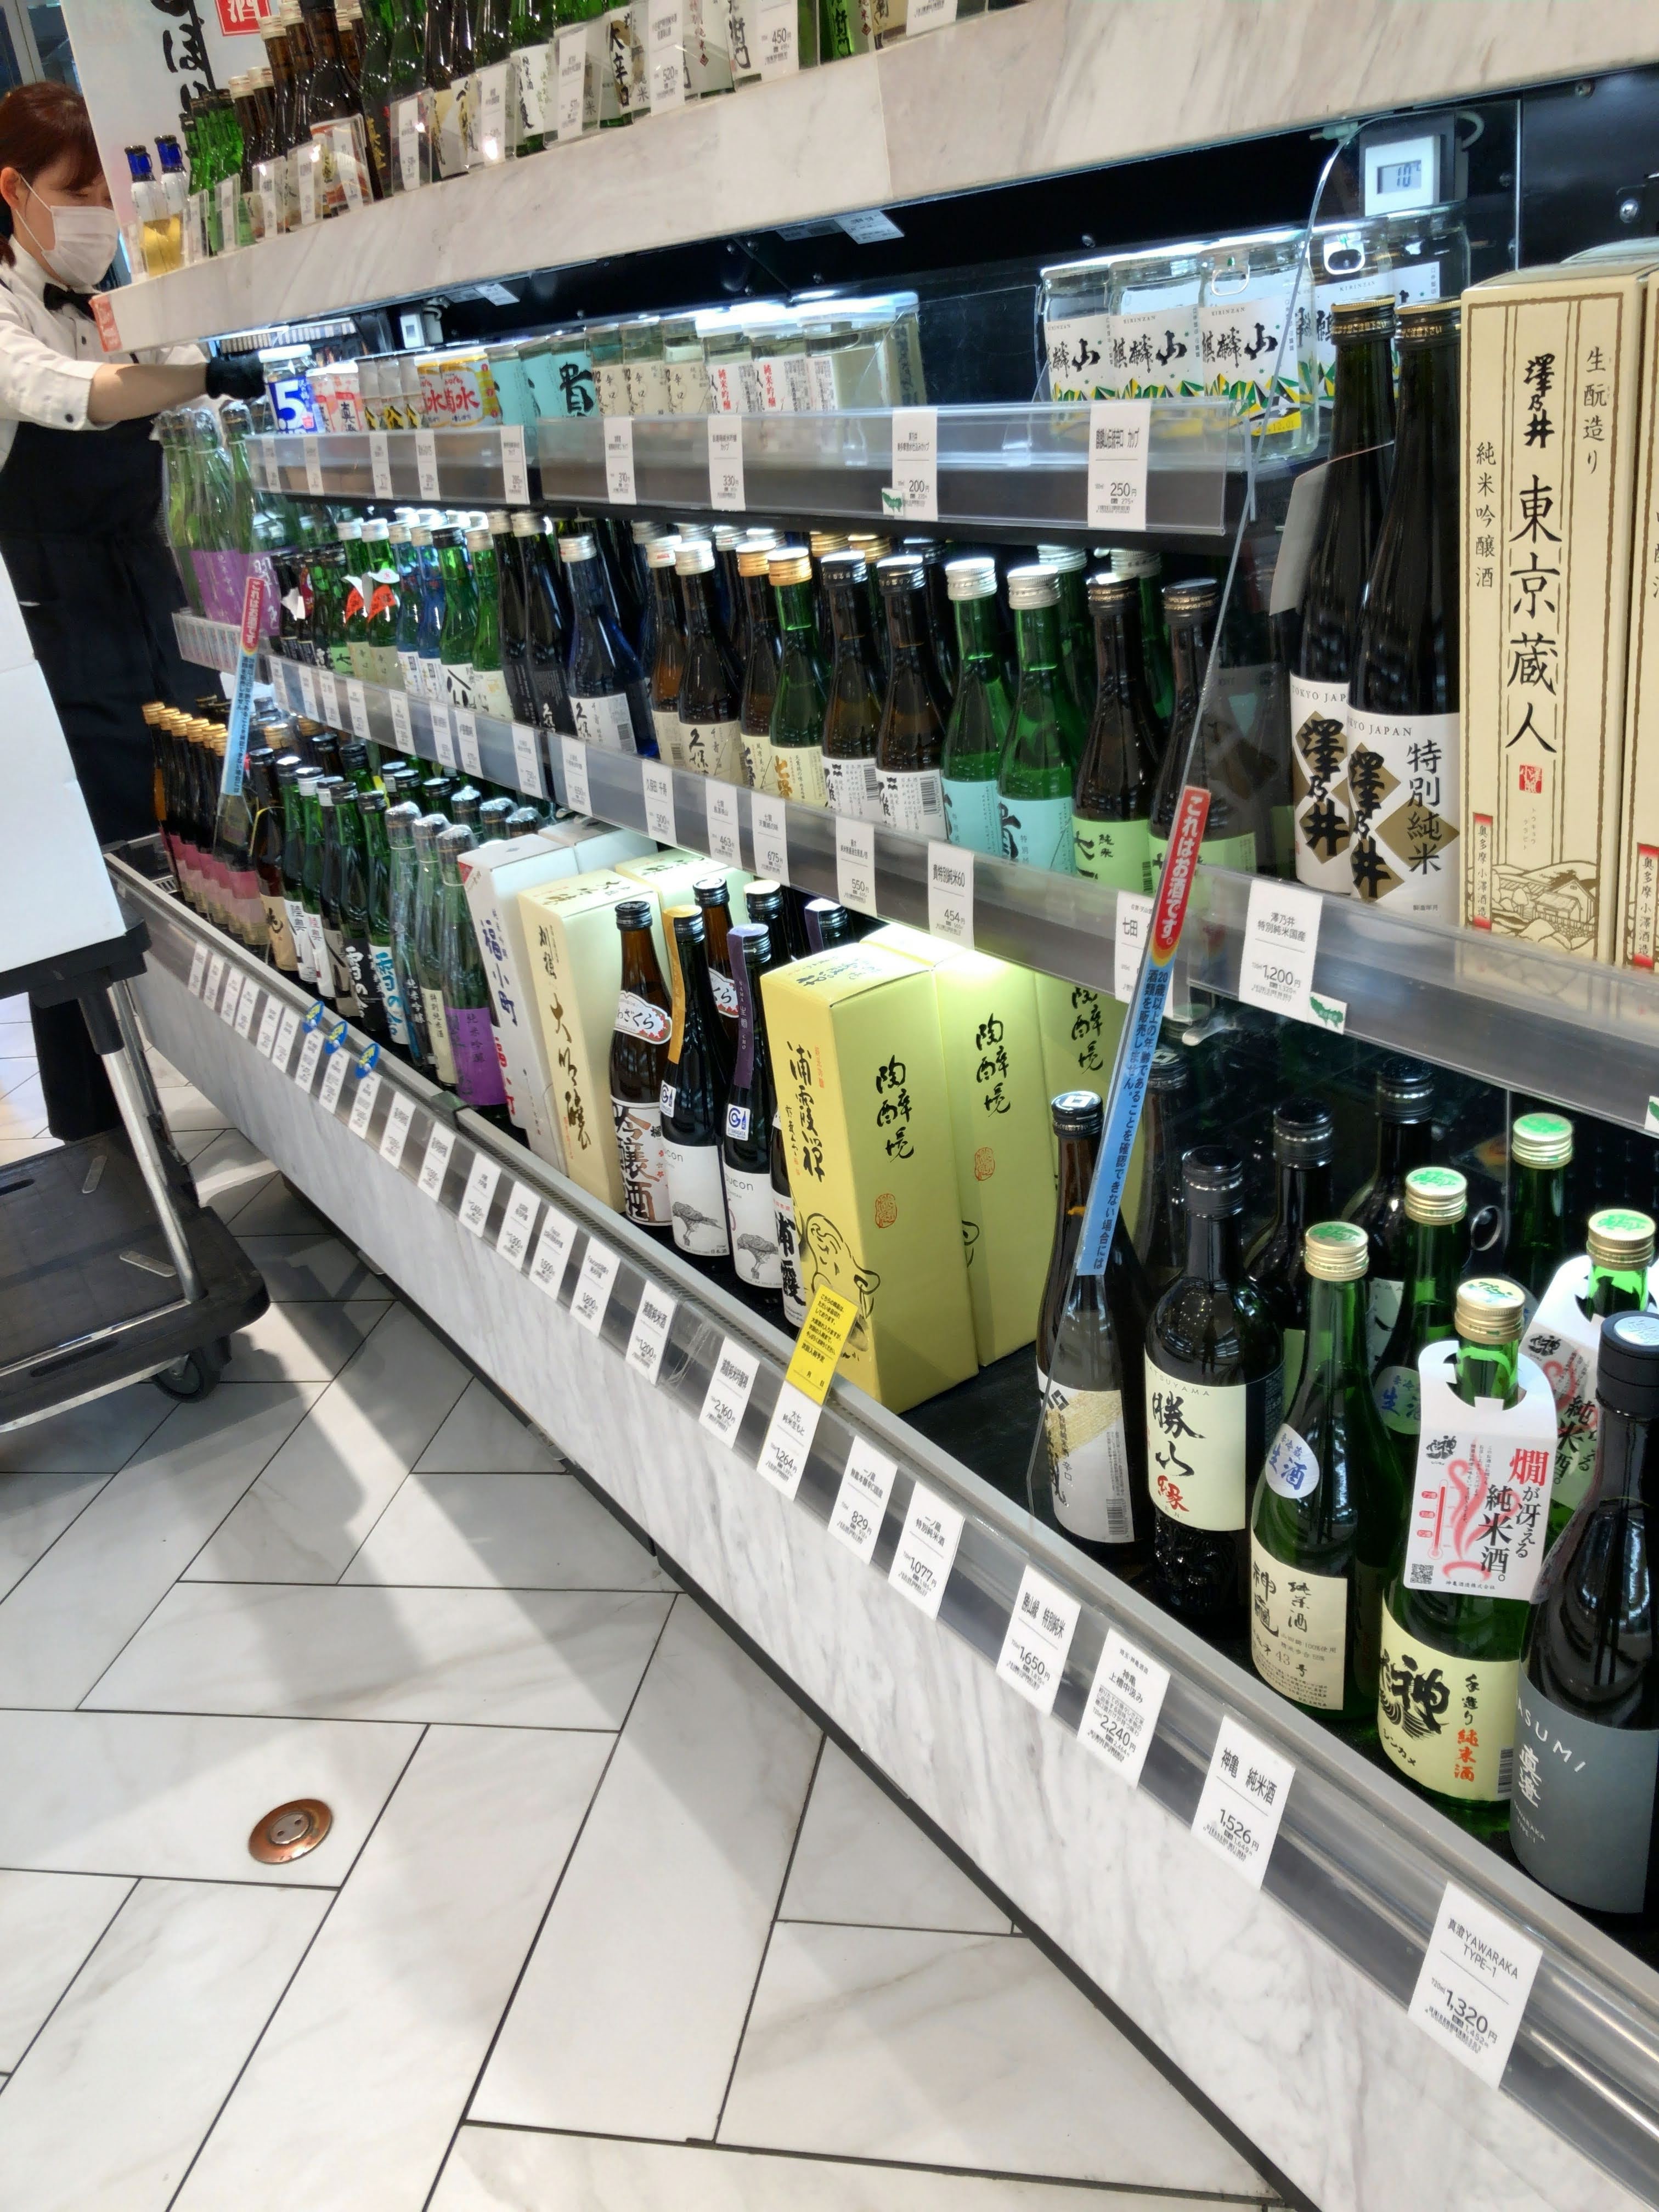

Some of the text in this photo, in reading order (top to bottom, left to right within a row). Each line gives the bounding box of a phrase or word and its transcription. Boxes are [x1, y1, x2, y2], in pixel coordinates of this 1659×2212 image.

[1211, 307, 1245, 317] KIRINZAN
[1523, 353, 1555, 449] 澤乃井
[909, 480, 929, 493] 200円
[1110, 483, 1137, 496] 250円
[1475, 442, 1497, 589] 純米吟醸酒
[1505, 474, 1562, 754] 東京蔵人
[1292, 685, 1348, 703] TOKYO JAP
[1368, 723, 1413, 737] JAPAN
[1300, 718, 1349, 856] 澤乃井
[1406, 739, 1442, 876] 特別純米
[1098, 833, 1115, 858] 純米
[1348, 751, 1391, 898] 澤乃井
[1477, 825, 1487, 864] 奥多摩
[767, 850, 783, 865] 675円
[1160, 795, 1204, 945] これはお酒です。
[851, 878, 869, 894] 550円
[944, 907, 964, 926] 454円
[1270, 911, 1295, 928] 澤乃井
[1262, 962, 1301, 990] 1,200円
[1123, 969, 1158, 1097] 酒類を販売しません。
[1093, 970, 1168, 1271] 20歳以上の年齢であることを確認できない場合には
[725, 1173, 754, 1191] aucon
[1152, 1391, 1207, 1477] 勝山
[775, 1447, 799, 1474] 1,264円
[1268, 1443, 1307, 1491] 生酒
[850, 1509, 873, 1536] 829円
[1508, 1448, 1550, 1559] 燗が冴える
[1476, 1483, 1514, 1582] 純米酒。
[909, 1555, 938, 1589] 1,077円
[1018, 1645, 1052, 1681] 1,650円
[1121, 1668, 1137, 1688] 神亀
[1462, 1673, 1480, 1726] 手造り
[1099, 1712, 1138, 1755] 2,240円
[1454, 1729, 1479, 1782] 純米酒
[1517, 1696, 1586, 1773] ASUMI
[1220, 1747, 1277, 1807] 神亀 純米酒
[1217, 1807, 1261, 1853] 1,526円
[1442, 1987, 1500, 2045] 1,320円
